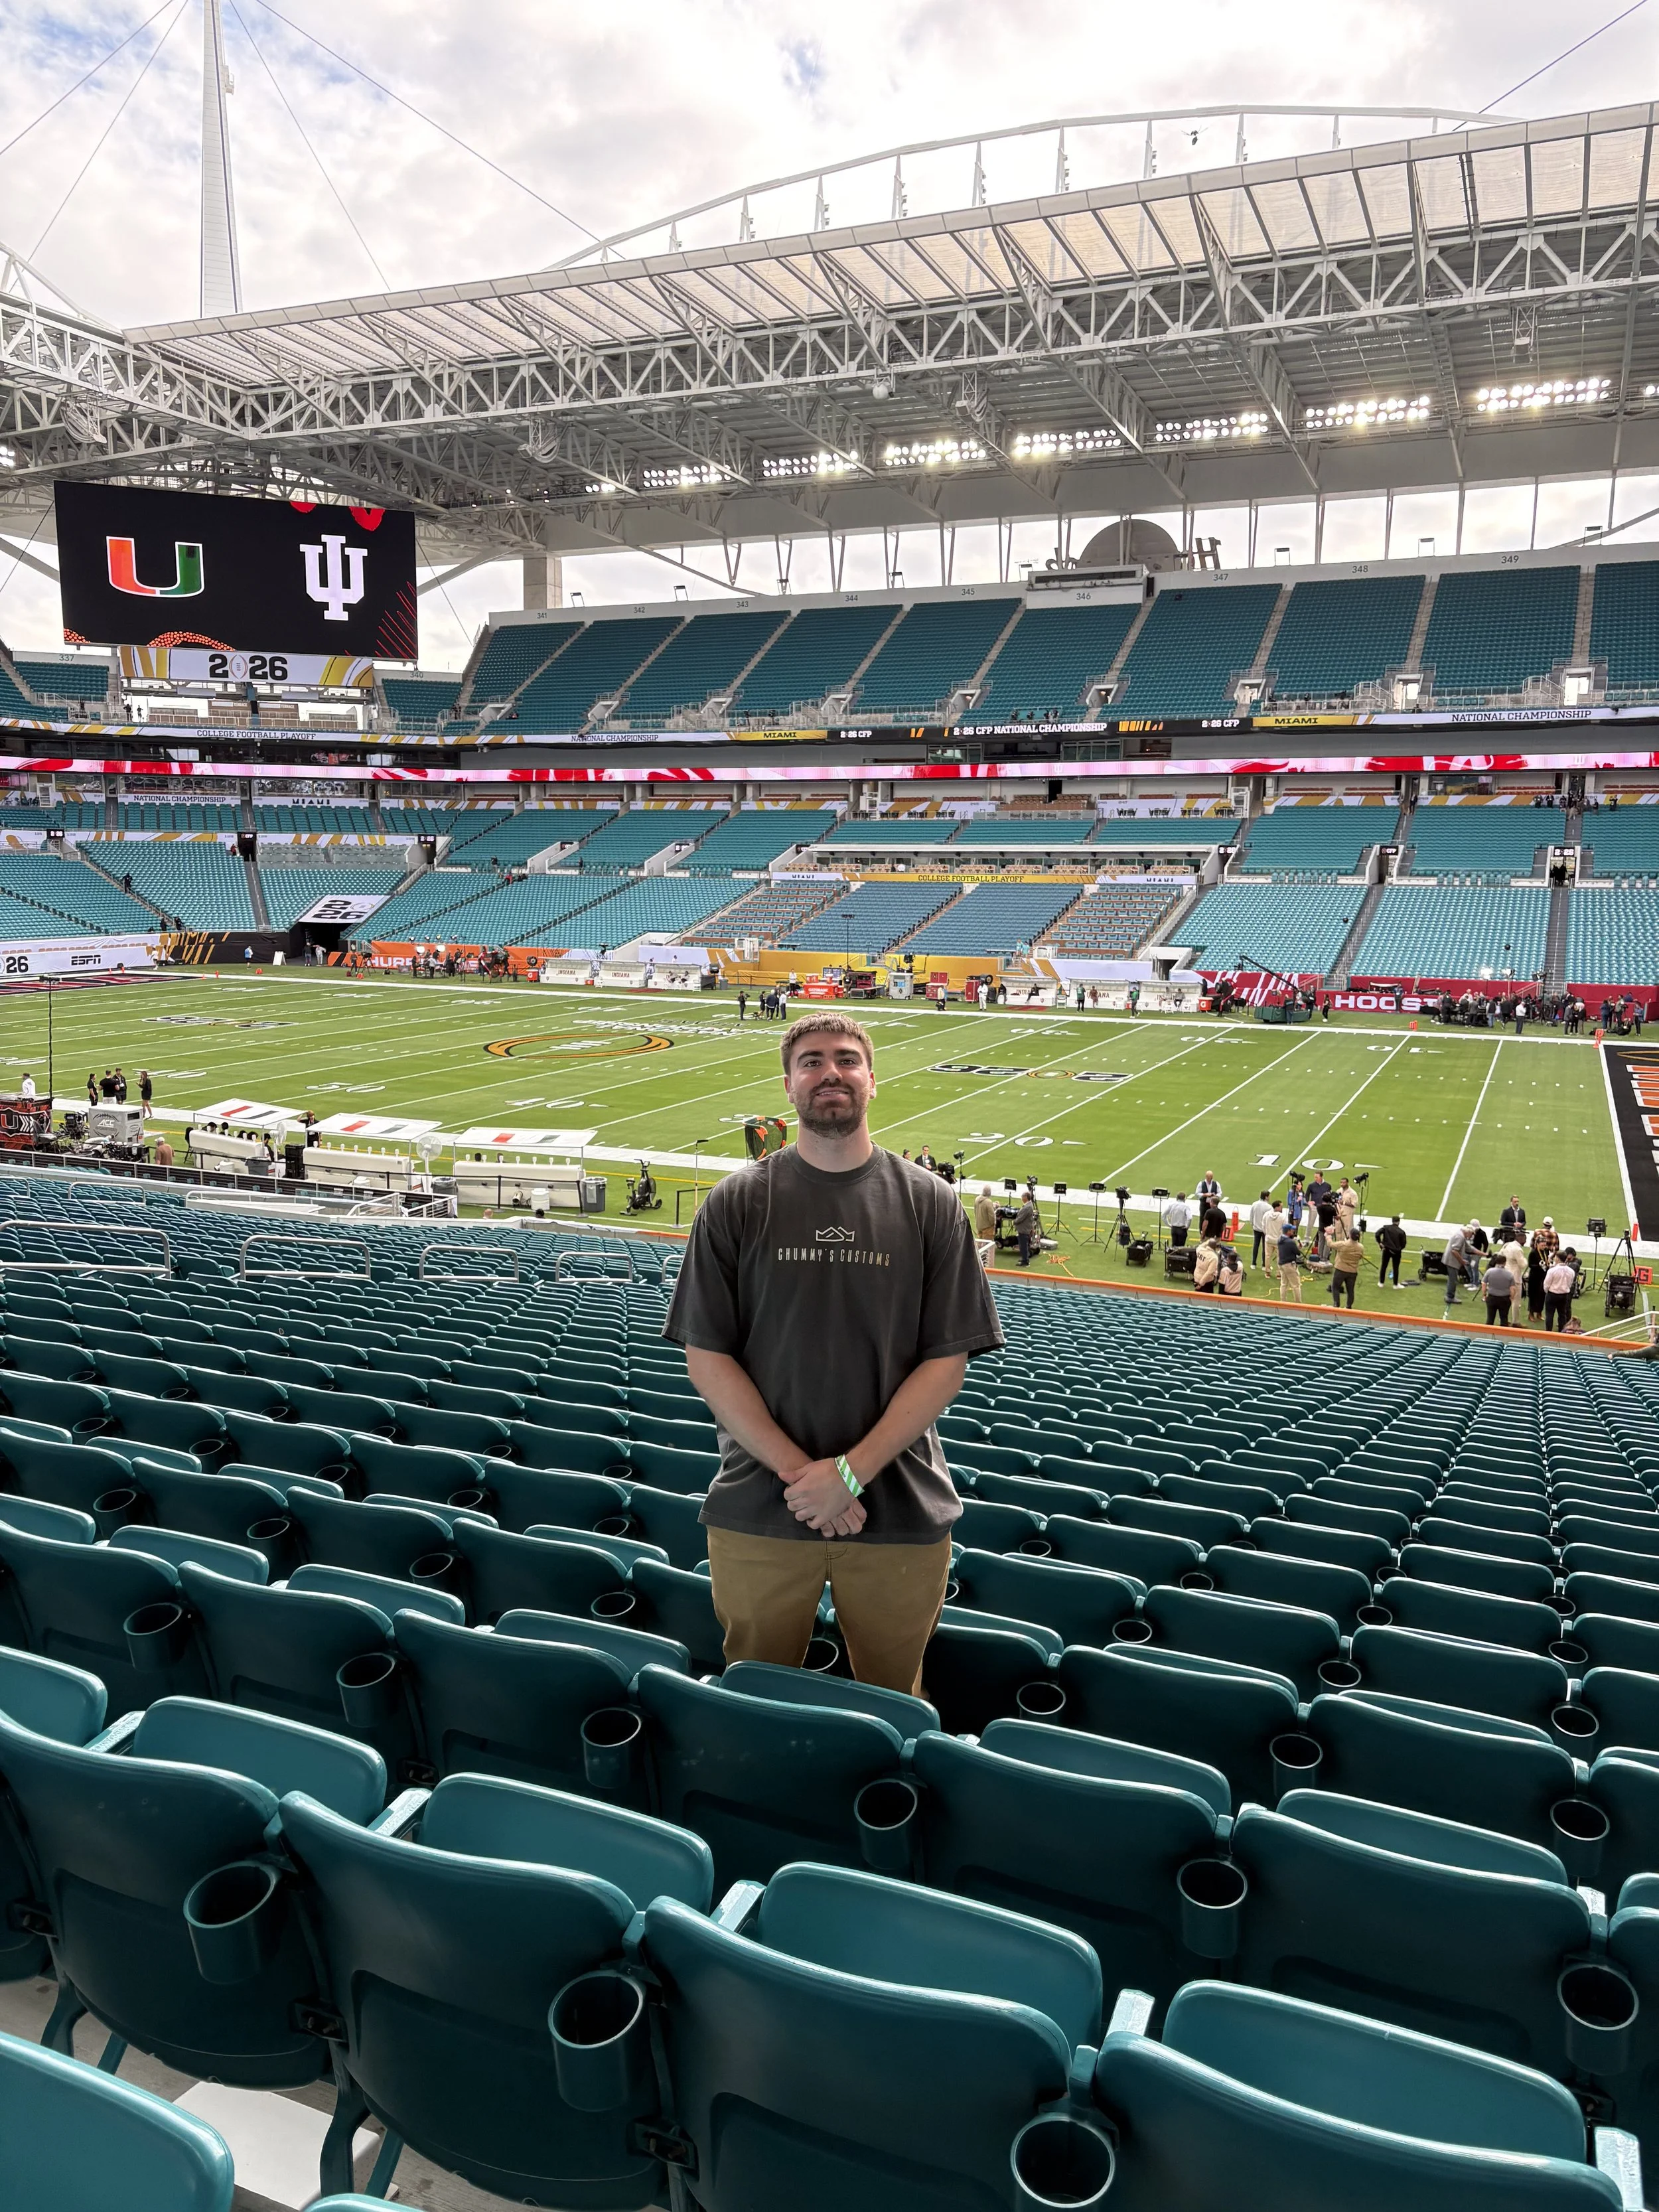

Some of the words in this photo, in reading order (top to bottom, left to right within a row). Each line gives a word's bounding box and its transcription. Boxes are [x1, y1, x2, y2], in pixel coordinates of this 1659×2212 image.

[1501, 555, 1519, 564] 349
[106, 536, 204, 597] U
[1352, 565, 1368, 573] 348
[1076, 593, 1091, 601] 346
[1452, 713, 1505, 722] NATIONAL
[1507, 710, 1591, 721] CHAMPIONSHIP
[975, 726, 992, 735] CFP
[993, 725, 1033, 734] NATIONAL
[1034, 723, 1107, 733] CHAMPIONSHIP
[72, 955, 101, 966] ESPN
[778, 1248, 834, 1262] CHUMMY'S
[839, 1249, 890, 1267] CUSTOMS
[1638, 1268, 1649, 1282] G
